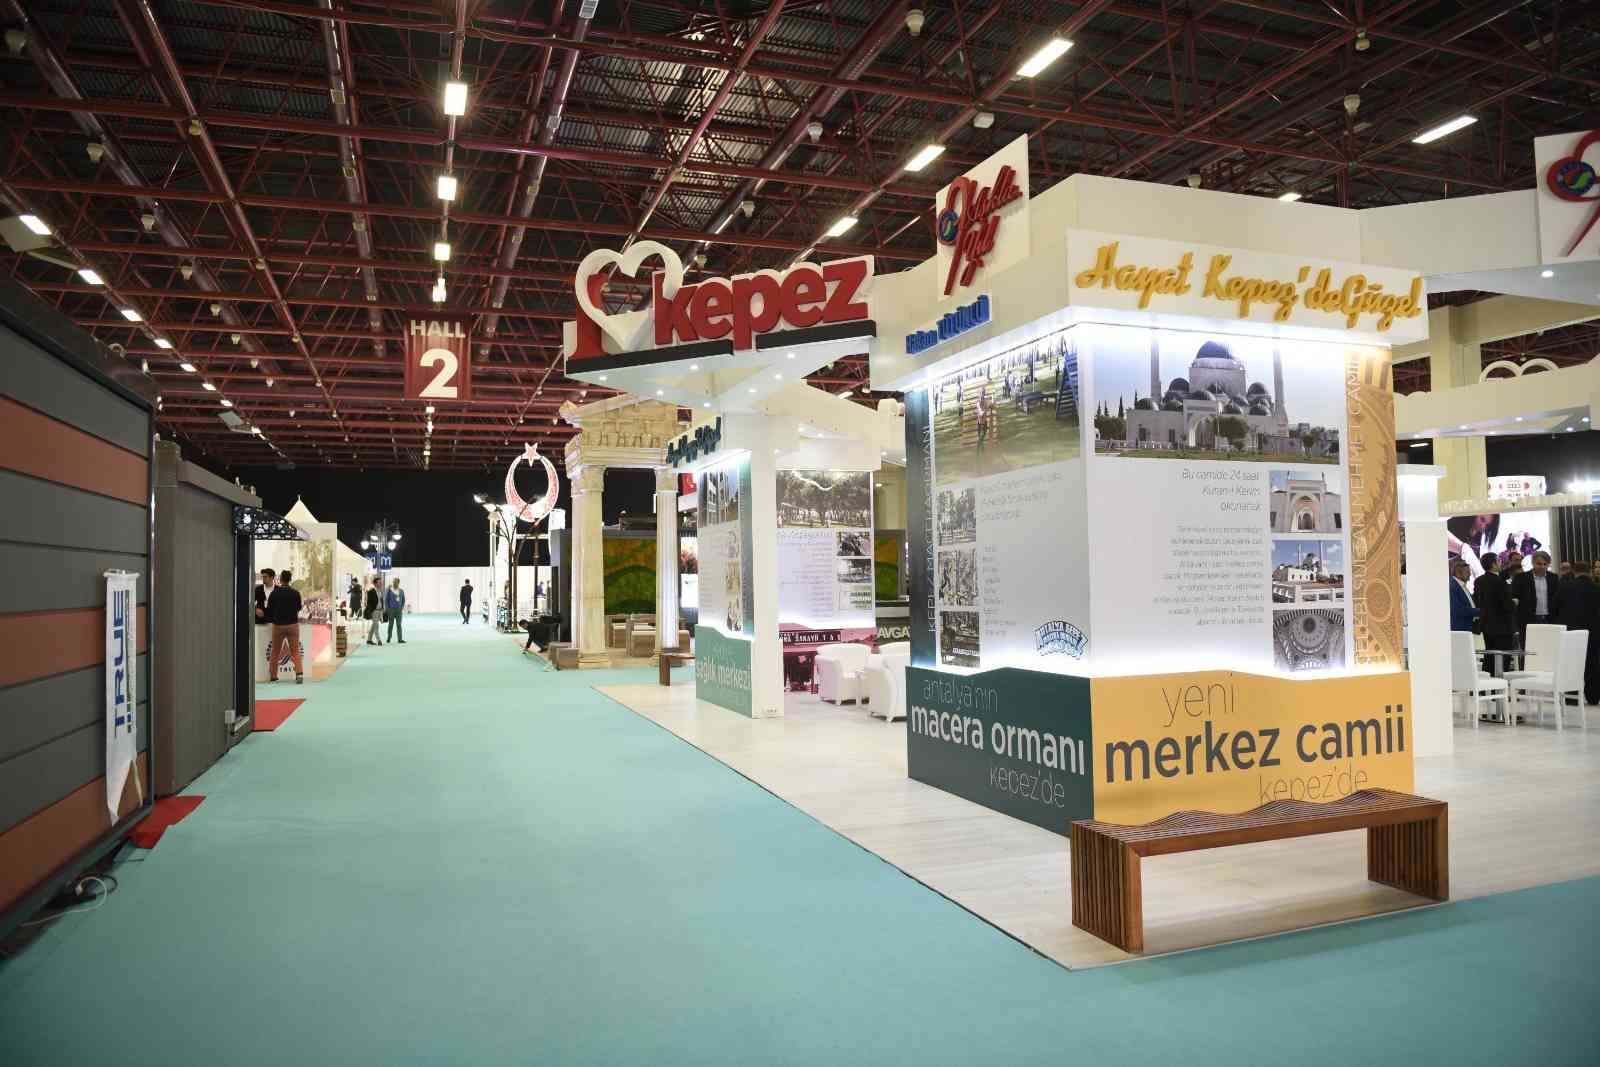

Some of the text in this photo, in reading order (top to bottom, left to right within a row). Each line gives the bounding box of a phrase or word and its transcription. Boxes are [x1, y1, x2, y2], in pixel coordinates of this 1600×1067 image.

[651, 260, 870, 351] kepez
[1075, 241, 1194, 309] Hayat
[410, 319, 466, 338] HALL
[419, 348, 458, 399] 2
[877, 626, 911, 639] AVGA
[1162, 672, 1238, 727] yeni
[911, 704, 1085, 776] macera ormanı
[1105, 704, 1405, 784] merkez camii
